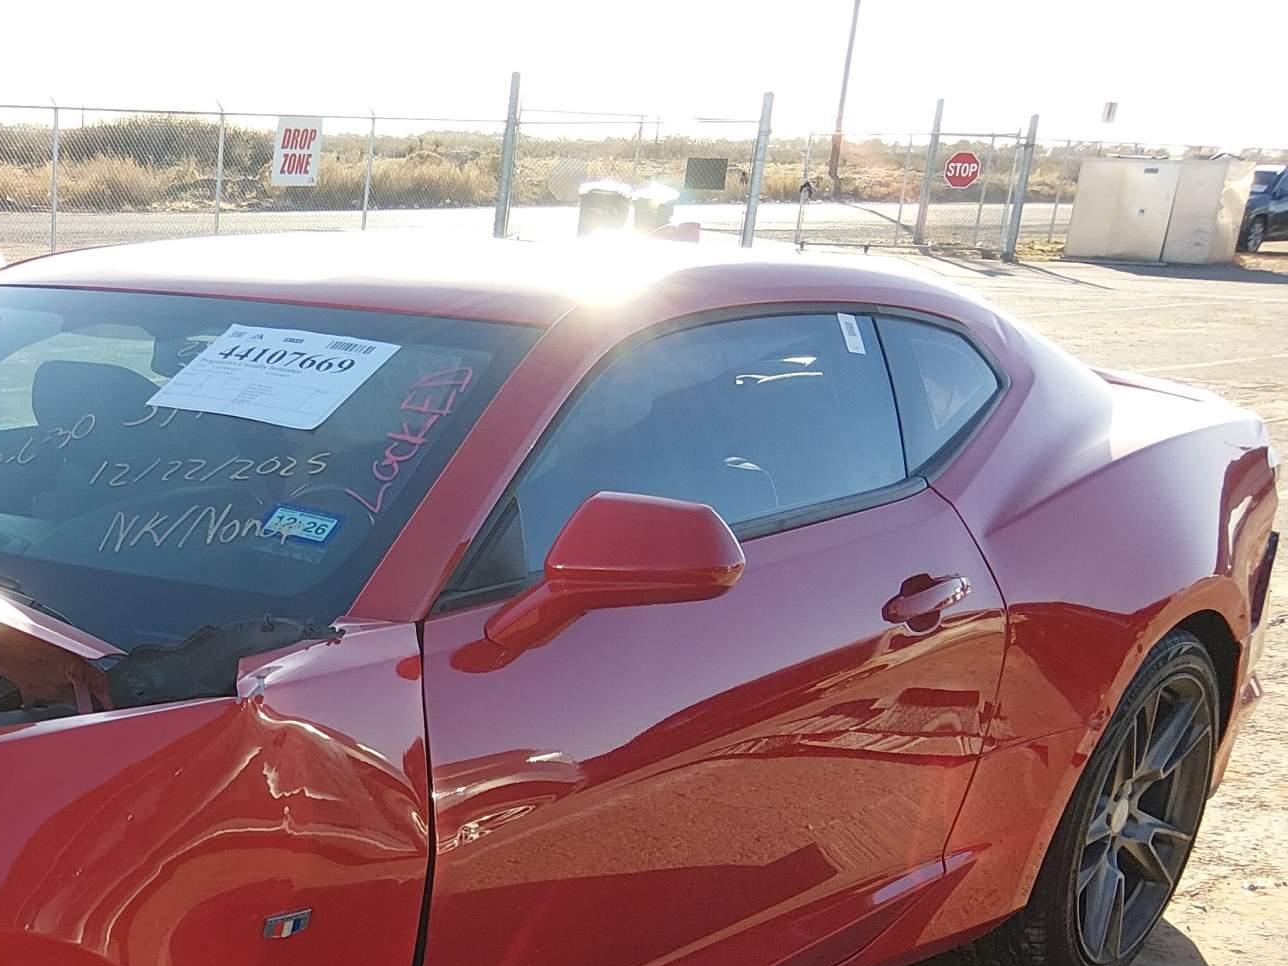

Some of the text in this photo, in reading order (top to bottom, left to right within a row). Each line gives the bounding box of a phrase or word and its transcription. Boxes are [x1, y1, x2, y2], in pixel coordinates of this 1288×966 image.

[281, 128, 317, 150] DROP
[280, 153, 312, 175] ZONE
[947, 162, 978, 177] STOP
[219, 344, 356, 374] 44107669
[89, 452, 331, 486] 12/22/2025
[303, 521, 328, 536] 26
